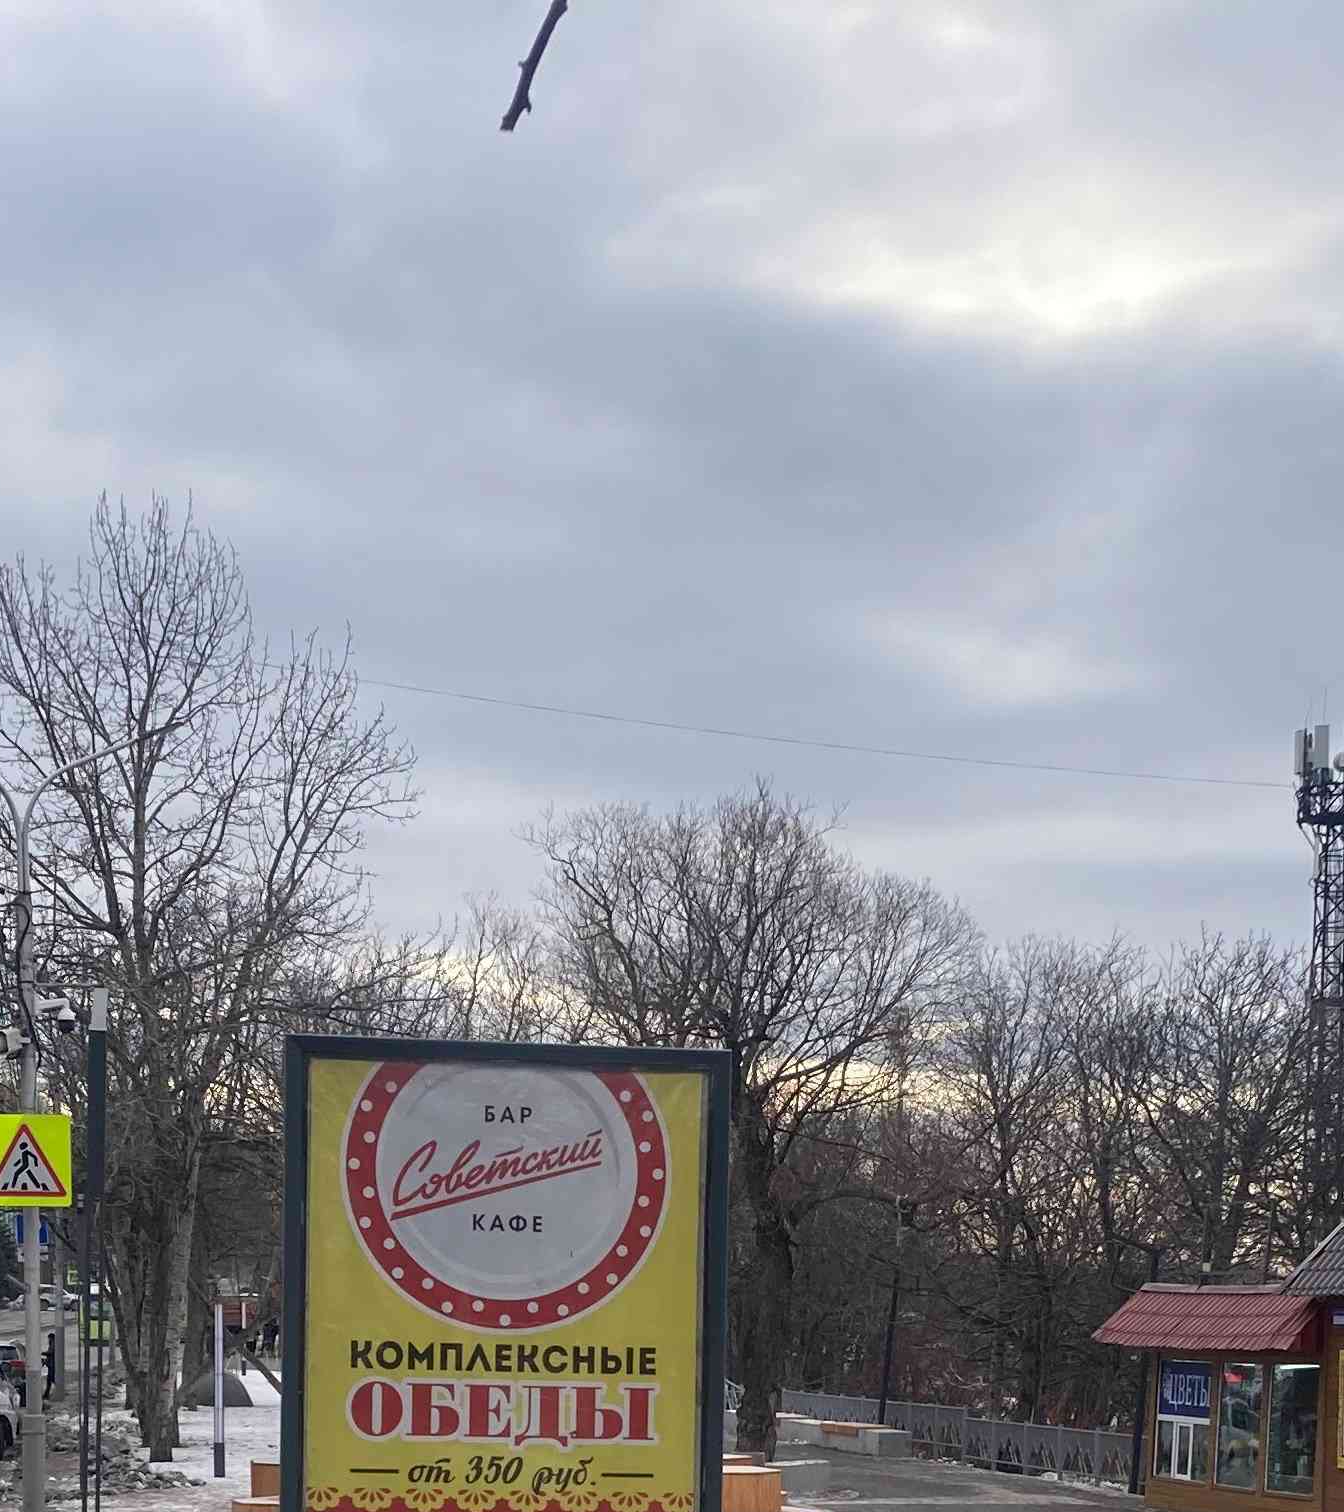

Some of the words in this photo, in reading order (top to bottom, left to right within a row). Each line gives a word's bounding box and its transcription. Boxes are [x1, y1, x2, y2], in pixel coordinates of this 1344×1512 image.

[484, 1105, 532, 1123] БАР
[391, 1129, 603, 1211] Советский
[472, 1213, 544, 1233] КАФЕ
[350, 1339, 656, 1375] КОМПЛЕКСНЫЕ
[1167, 1373, 1212, 1411] ЦВЕТЫ
[349, 1379, 657, 1448] ОБЕДЫ
[408, 1457, 456, 1484] от
[465, 1455, 524, 1484] 350
[532, 1456, 597, 1495] руб.
